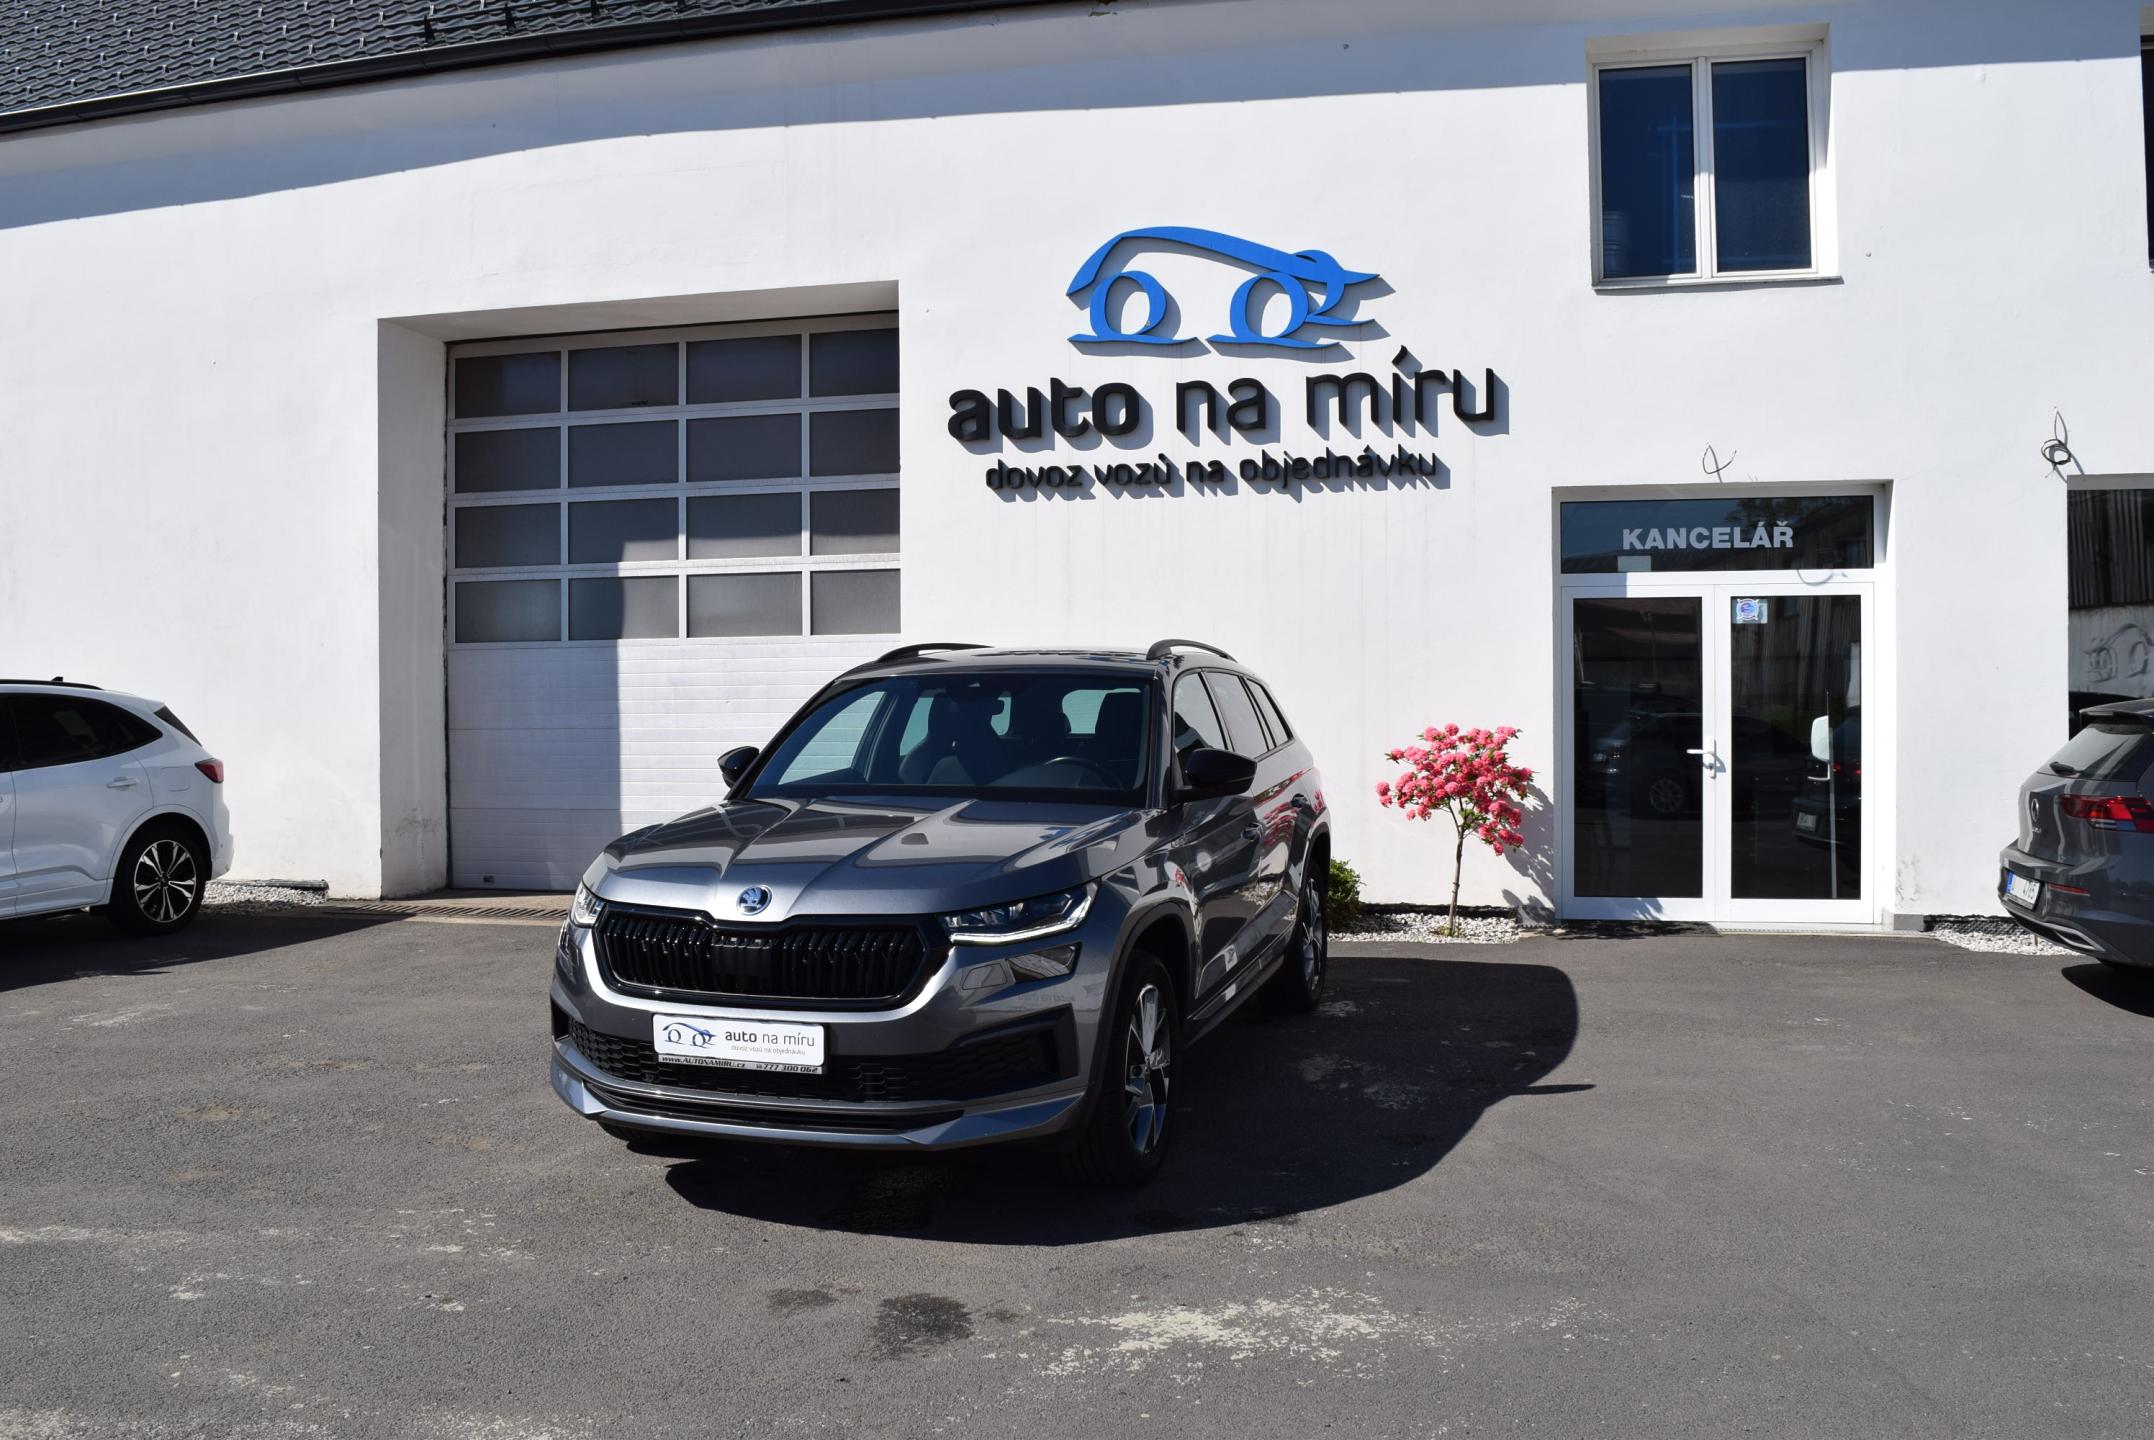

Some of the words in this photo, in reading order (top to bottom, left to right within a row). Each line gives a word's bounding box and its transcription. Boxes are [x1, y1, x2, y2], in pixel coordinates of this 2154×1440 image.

[947, 377, 1140, 442] auto
[1176, 377, 1267, 433] na
[1305, 344, 1495, 432] míru
[985, 459, 1083, 490] dovoz
[1186, 460, 1225, 484] na
[1239, 443, 1438, 489] objednávku
[1622, 521, 1794, 550] KANCELÁŘ
[725, 1031, 757, 1043] auto
[762, 1033, 778, 1044] na
[783, 1032, 815, 1047] míru
[763, 1063, 779, 1071] 777
